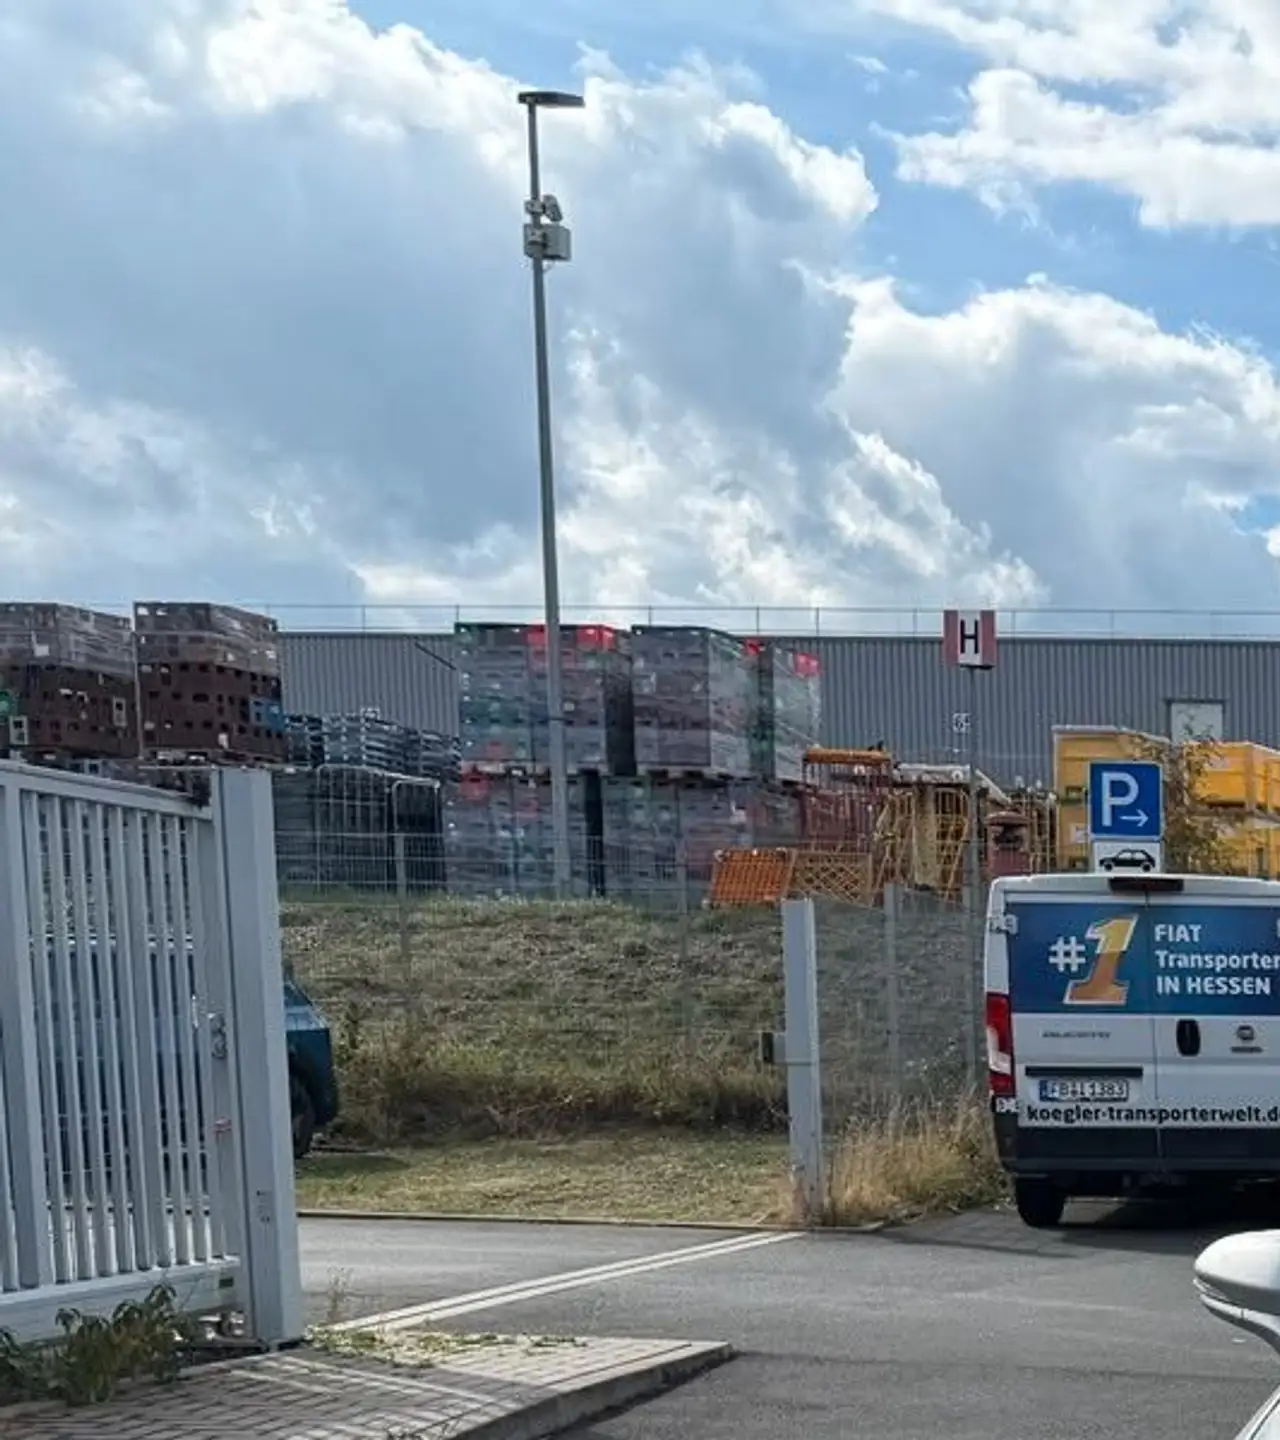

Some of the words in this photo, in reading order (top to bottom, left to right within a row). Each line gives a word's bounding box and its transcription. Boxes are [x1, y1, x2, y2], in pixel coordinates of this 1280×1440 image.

[960, 619, 979, 654] H
[1101, 771, 1140, 827] P
[1154, 923, 1202, 942] FIAT
[1157, 976, 1181, 995] IN
[1186, 976, 1272, 996] HESSEN
